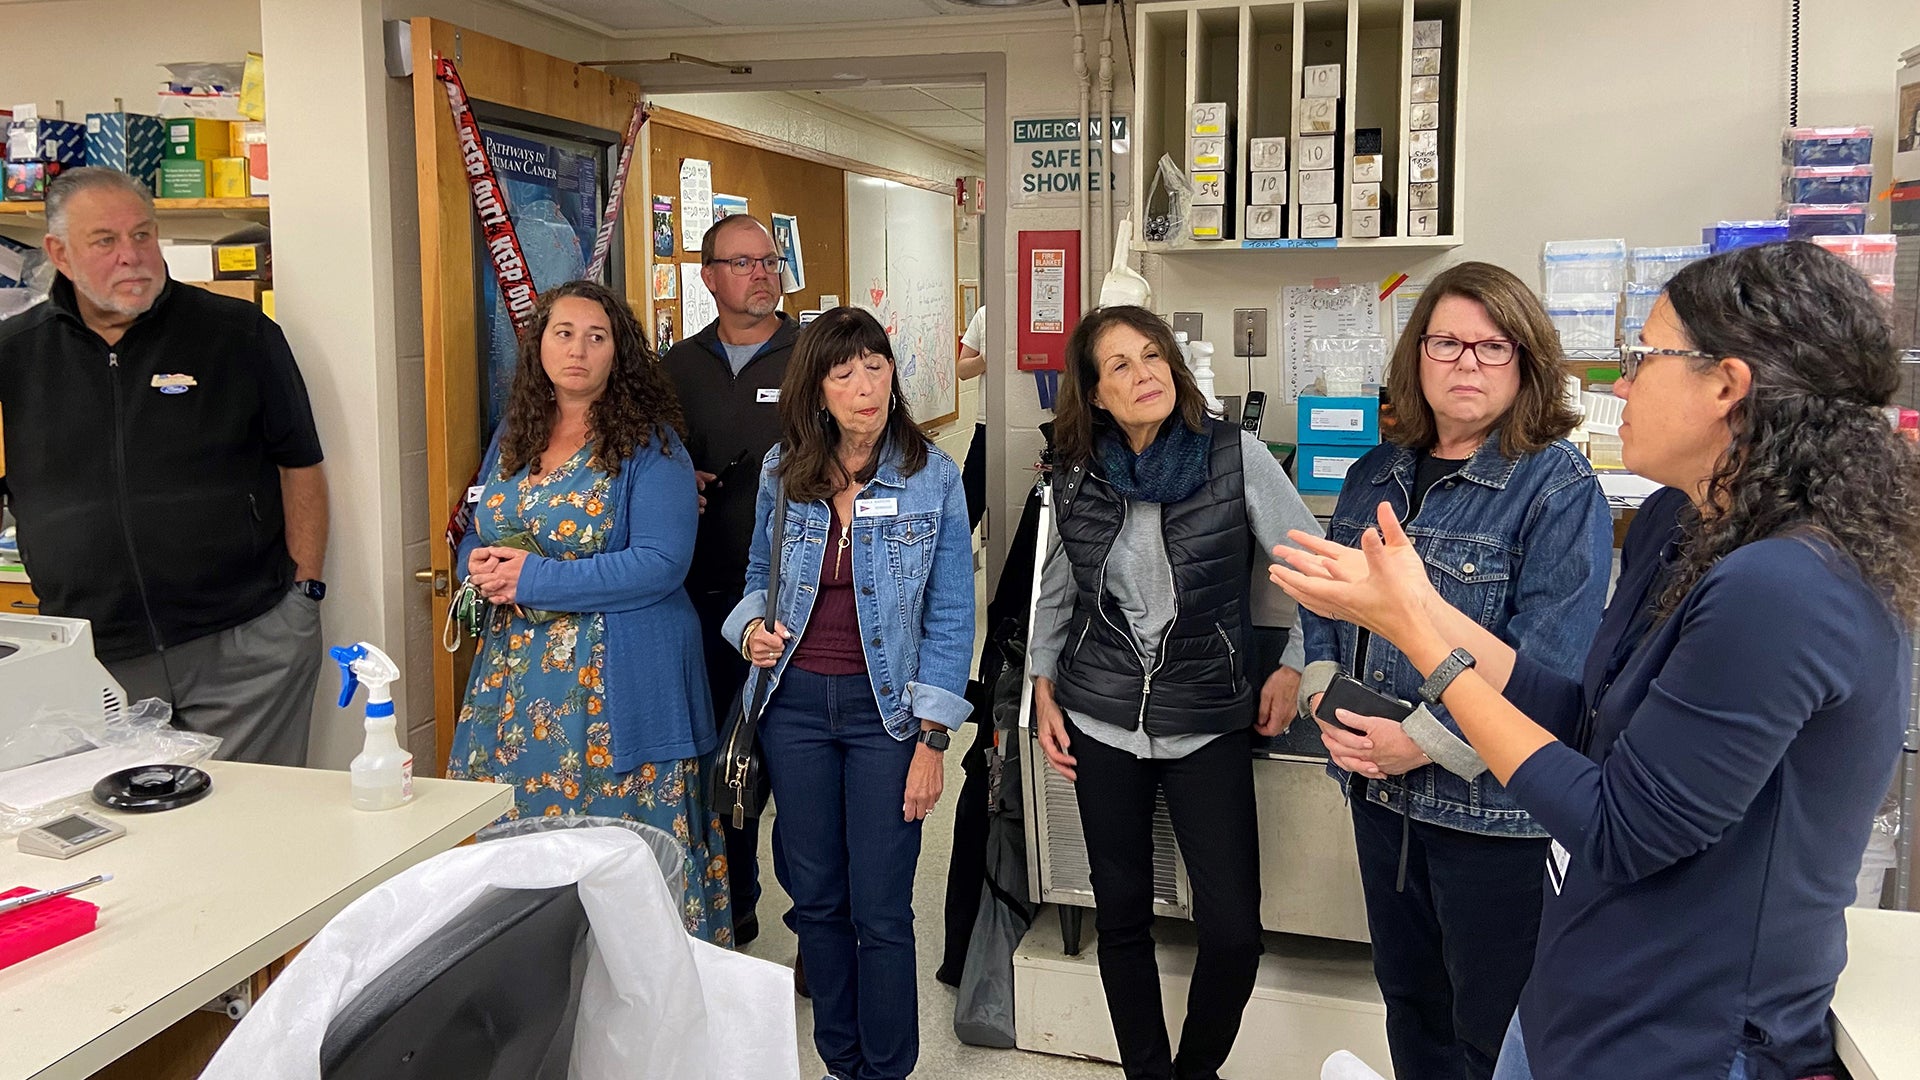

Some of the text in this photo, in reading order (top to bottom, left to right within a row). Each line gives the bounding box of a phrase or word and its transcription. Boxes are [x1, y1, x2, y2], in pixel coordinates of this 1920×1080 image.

[1196, 107, 1216, 124] 25
[1016, 121, 1122, 139] EMERGNY
[486, 137, 545, 163] PATHWAYS IN
[1200, 141, 1220, 155] 25
[1308, 146, 1323, 161] 10
[523, 160, 557, 180] CANCER
[1261, 177, 1277, 192] 10
[1302, 174, 1310, 183] 10
[1357, 189, 1368, 200] 5
[1255, 210, 1272, 224] 10
[1360, 216, 1372, 228] 5
[1418, 216, 1427, 231] 9
[490, 236, 523, 281] KEEP
